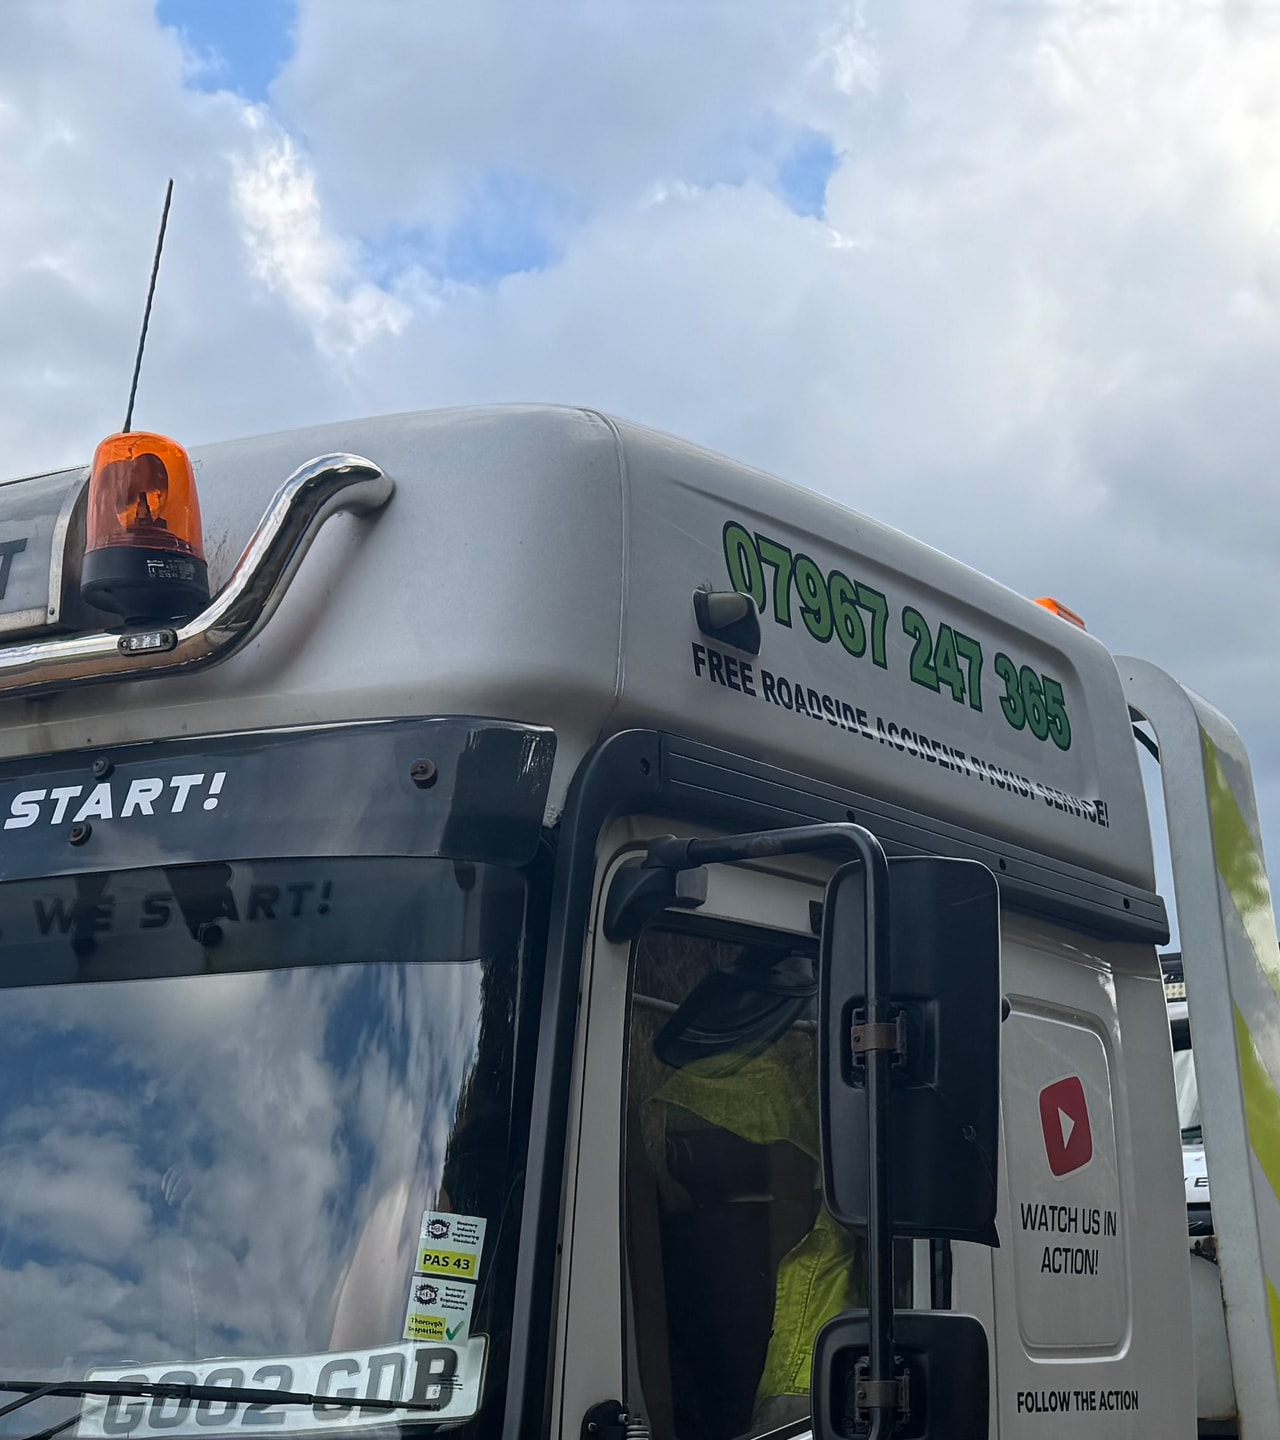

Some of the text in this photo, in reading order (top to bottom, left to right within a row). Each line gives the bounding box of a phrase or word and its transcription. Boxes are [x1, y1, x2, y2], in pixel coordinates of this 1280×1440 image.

[722, 520, 1072, 752] 07967 247 365
[692, 642, 757, 698] FREE
[761, 669, 874, 741] ROADSIDE
[877, 716, 971, 777] ACCIDENT
[1034, 781, 1110, 829] SERVICE!
[3, 771, 227, 830] START!
[1020, 1202, 1117, 1237] WATCH US IN
[423, 1253, 470, 1270] PAS 43
[1041, 1246, 1099, 1275] ACTION!
[309, 1346, 459, 1422] GDB
[1017, 1390, 1139, 1413] FOLLOW THE ACTION
